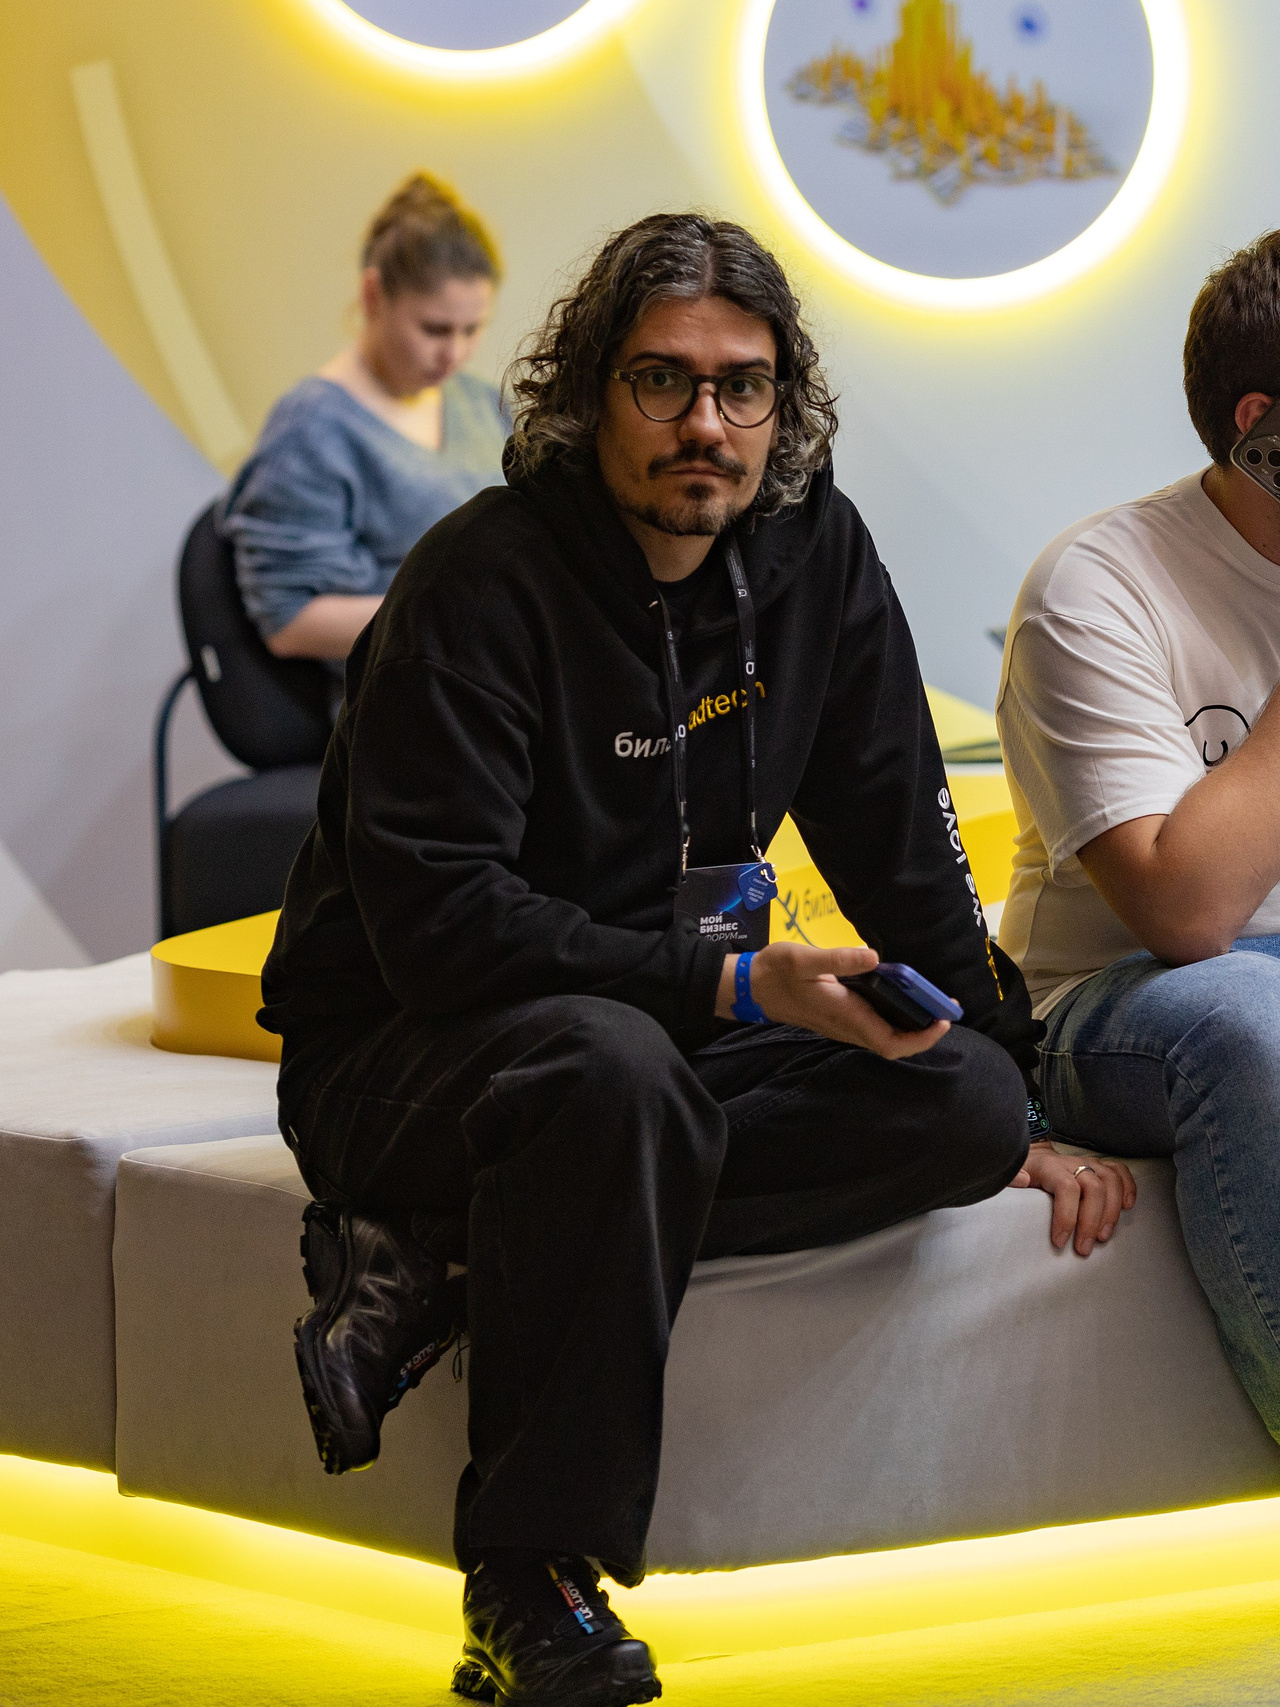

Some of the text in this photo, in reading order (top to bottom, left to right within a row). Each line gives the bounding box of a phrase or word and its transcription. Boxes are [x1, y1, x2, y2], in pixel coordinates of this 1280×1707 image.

[614, 731, 672, 759] бил
[700, 911, 723, 925] МОЙ
[700, 922, 739, 934] БИЗНЕС
